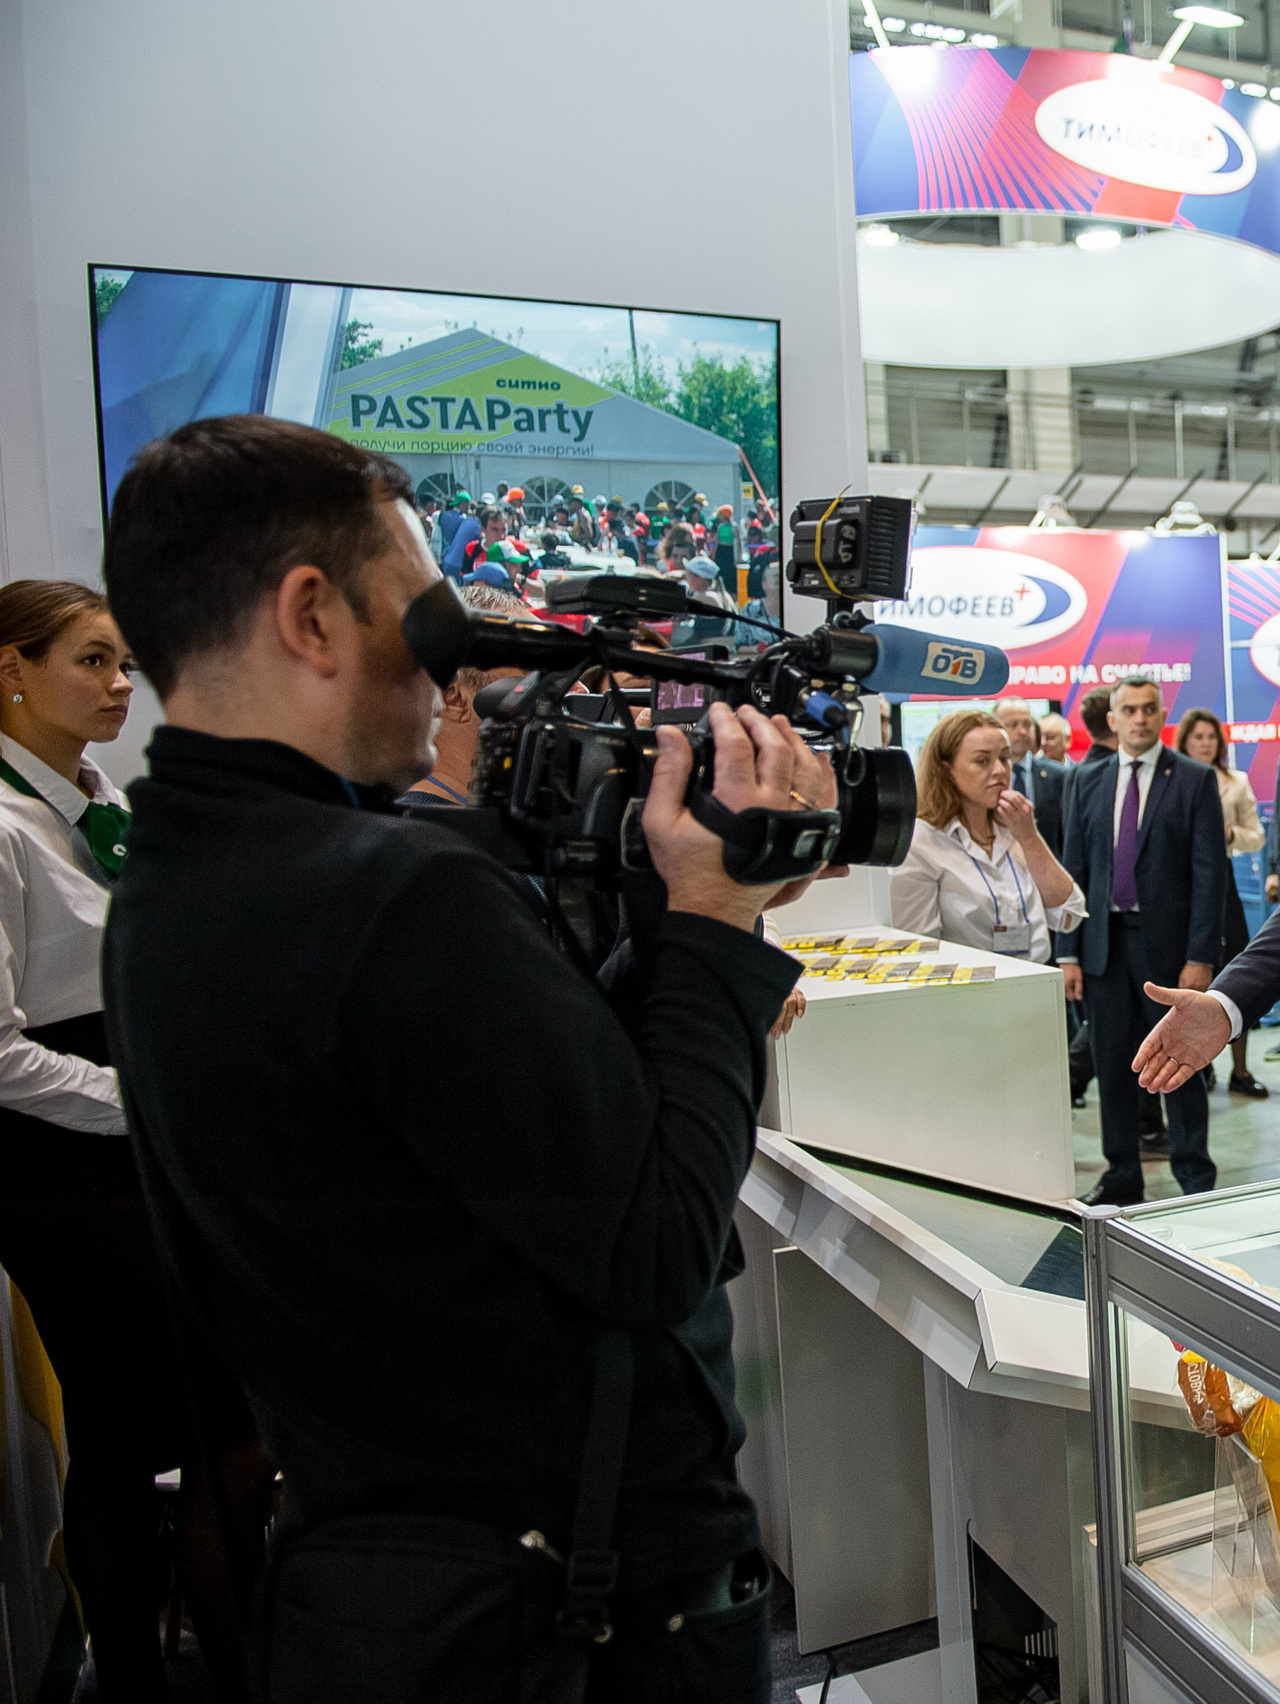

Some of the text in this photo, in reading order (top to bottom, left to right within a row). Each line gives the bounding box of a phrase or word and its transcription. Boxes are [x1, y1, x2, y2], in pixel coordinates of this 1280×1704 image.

[496, 378, 562, 391] ситно
[350, 394, 594, 442] PASTAParty
[351, 438, 594, 457] получи порцию своей энергии!
[879, 594, 1014, 617] ИМОФЕЕВ
[1070, 665, 1099, 684] НА
